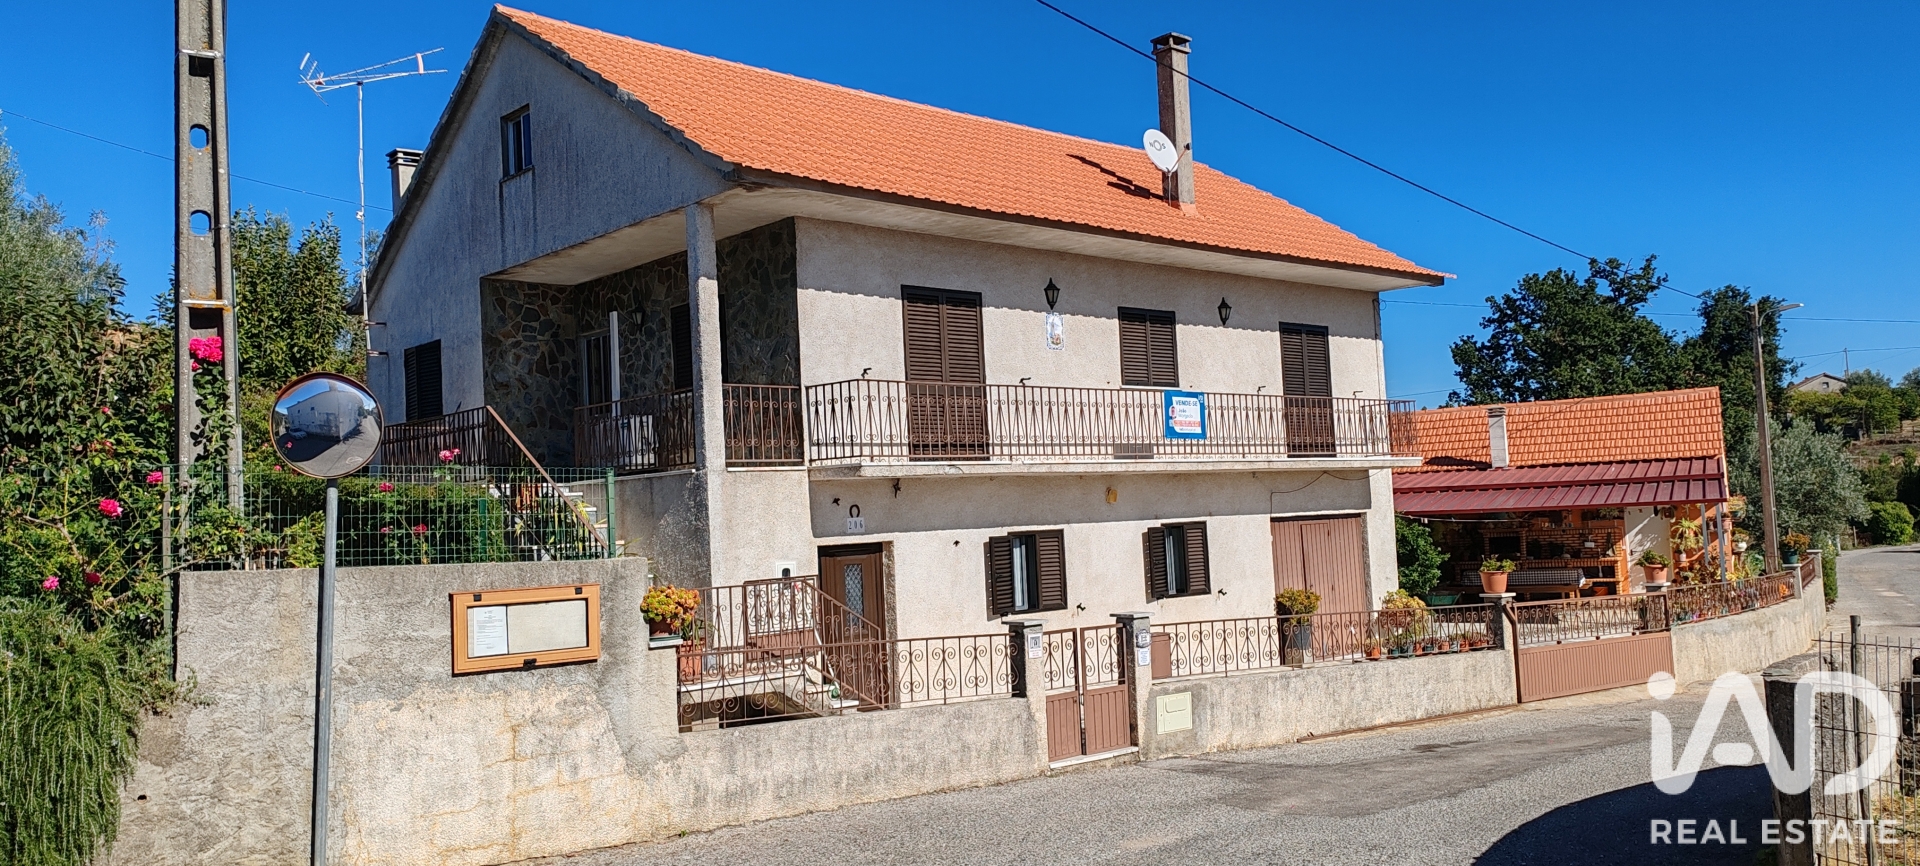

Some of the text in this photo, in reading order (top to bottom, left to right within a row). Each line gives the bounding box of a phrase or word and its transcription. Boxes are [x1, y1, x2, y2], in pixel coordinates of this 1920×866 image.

[1148, 139, 1167, 152] NOS
[1175, 399, 1198, 407] VENDE-SE
[848, 519, 864, 530] 206
